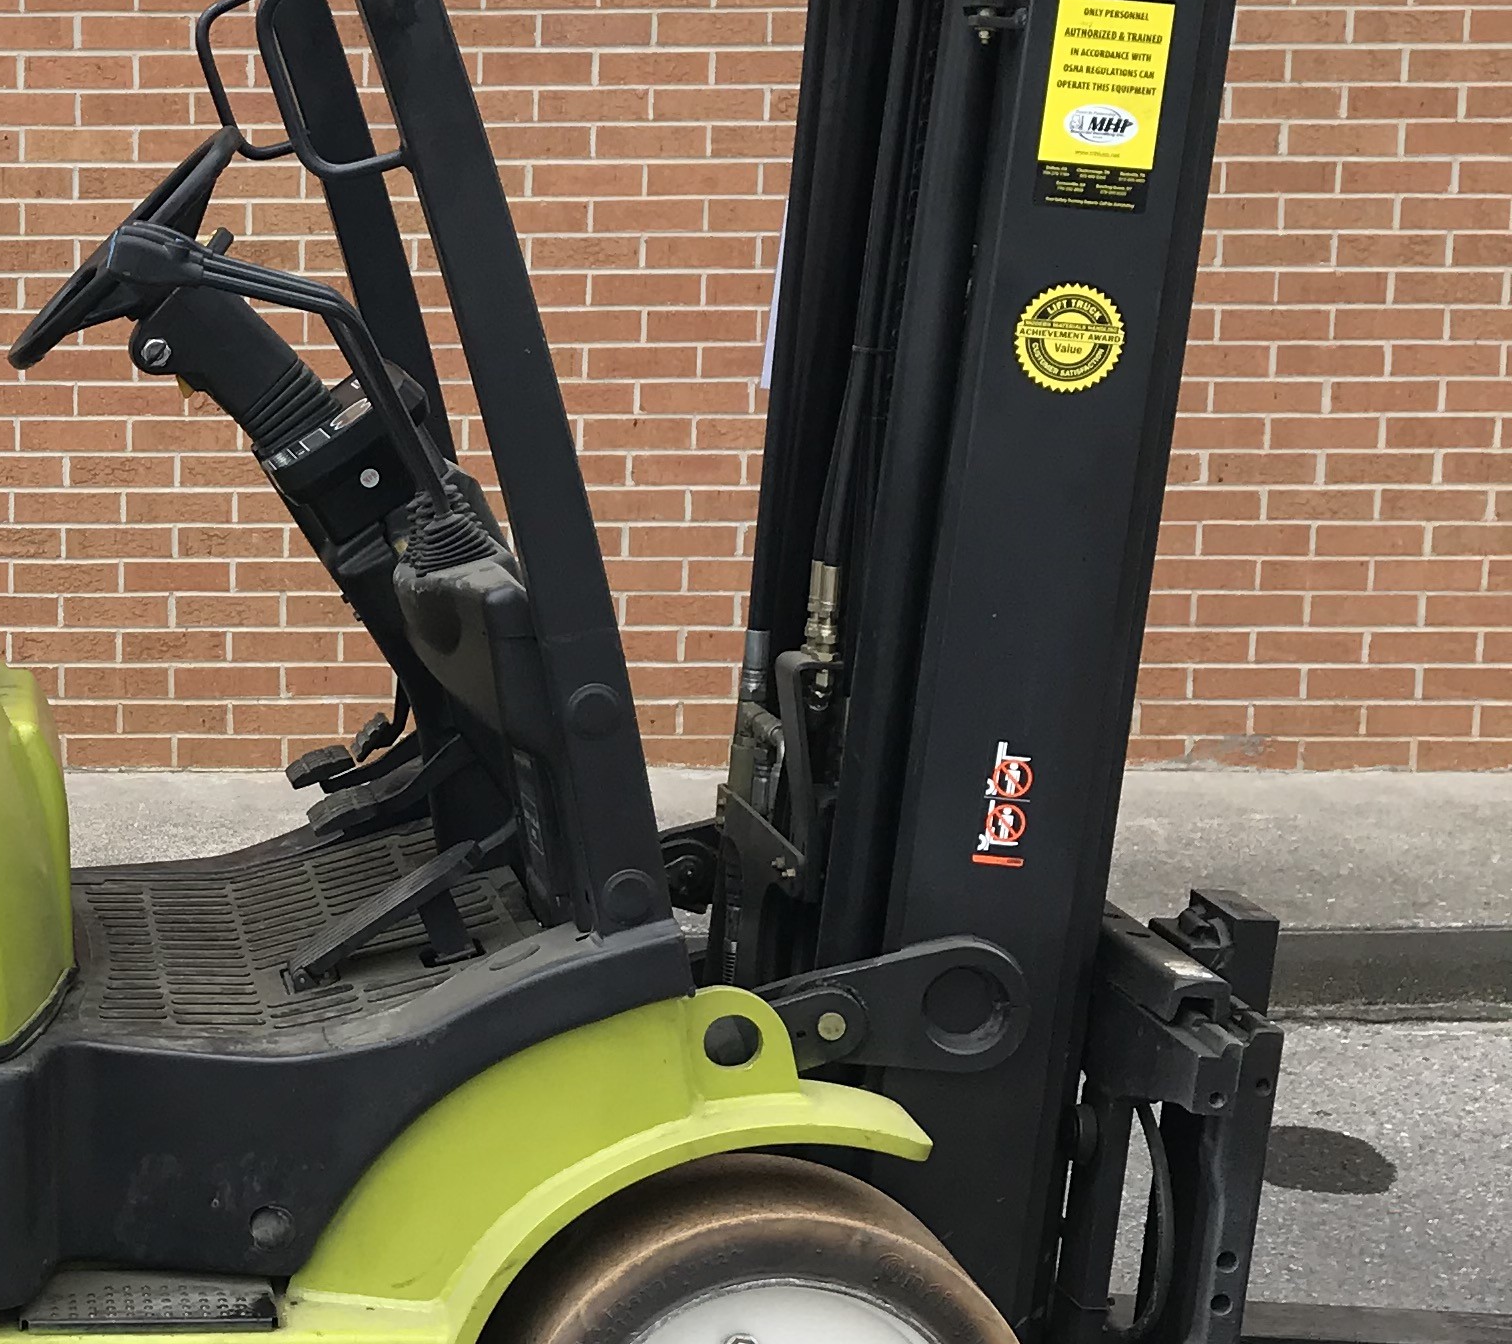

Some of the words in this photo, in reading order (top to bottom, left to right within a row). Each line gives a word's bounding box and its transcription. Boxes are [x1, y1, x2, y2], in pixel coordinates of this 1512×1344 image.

[1083, 7, 1103, 17] ONLY
[1104, 9, 1149, 21] PERSONNEL
[1064, 27, 1118, 41] AUTHORIZED
[1118, 31, 1126, 42] &
[1127, 31, 1163, 44] TRAINED
[1070, 47, 1079, 56] IN
[1080, 48, 1130, 60] ACCORDANCE
[1131, 52, 1152, 62] WITH
[1063, 63, 1084, 73] OSHA
[1085, 65, 1138, 78] REGULATIONS
[1138, 70, 1155, 79] CAN
[1056, 79, 1091, 90] OPERATE
[1092, 82, 1110, 92] THIS
[1111, 83, 1157, 96] EQUIPMENT
[1046, 299, 1068, 314] LIFT
[1071, 299, 1102, 320] TRUCK
[1019, 327, 1085, 340] ACHIEVEMENT
[1087, 333, 1121, 343] AWARD
[1054, 343, 1083, 354] Value
[1031, 341, 1059, 375] CUSTOMER
[1059, 348, 1105, 377] SATISFACTION
